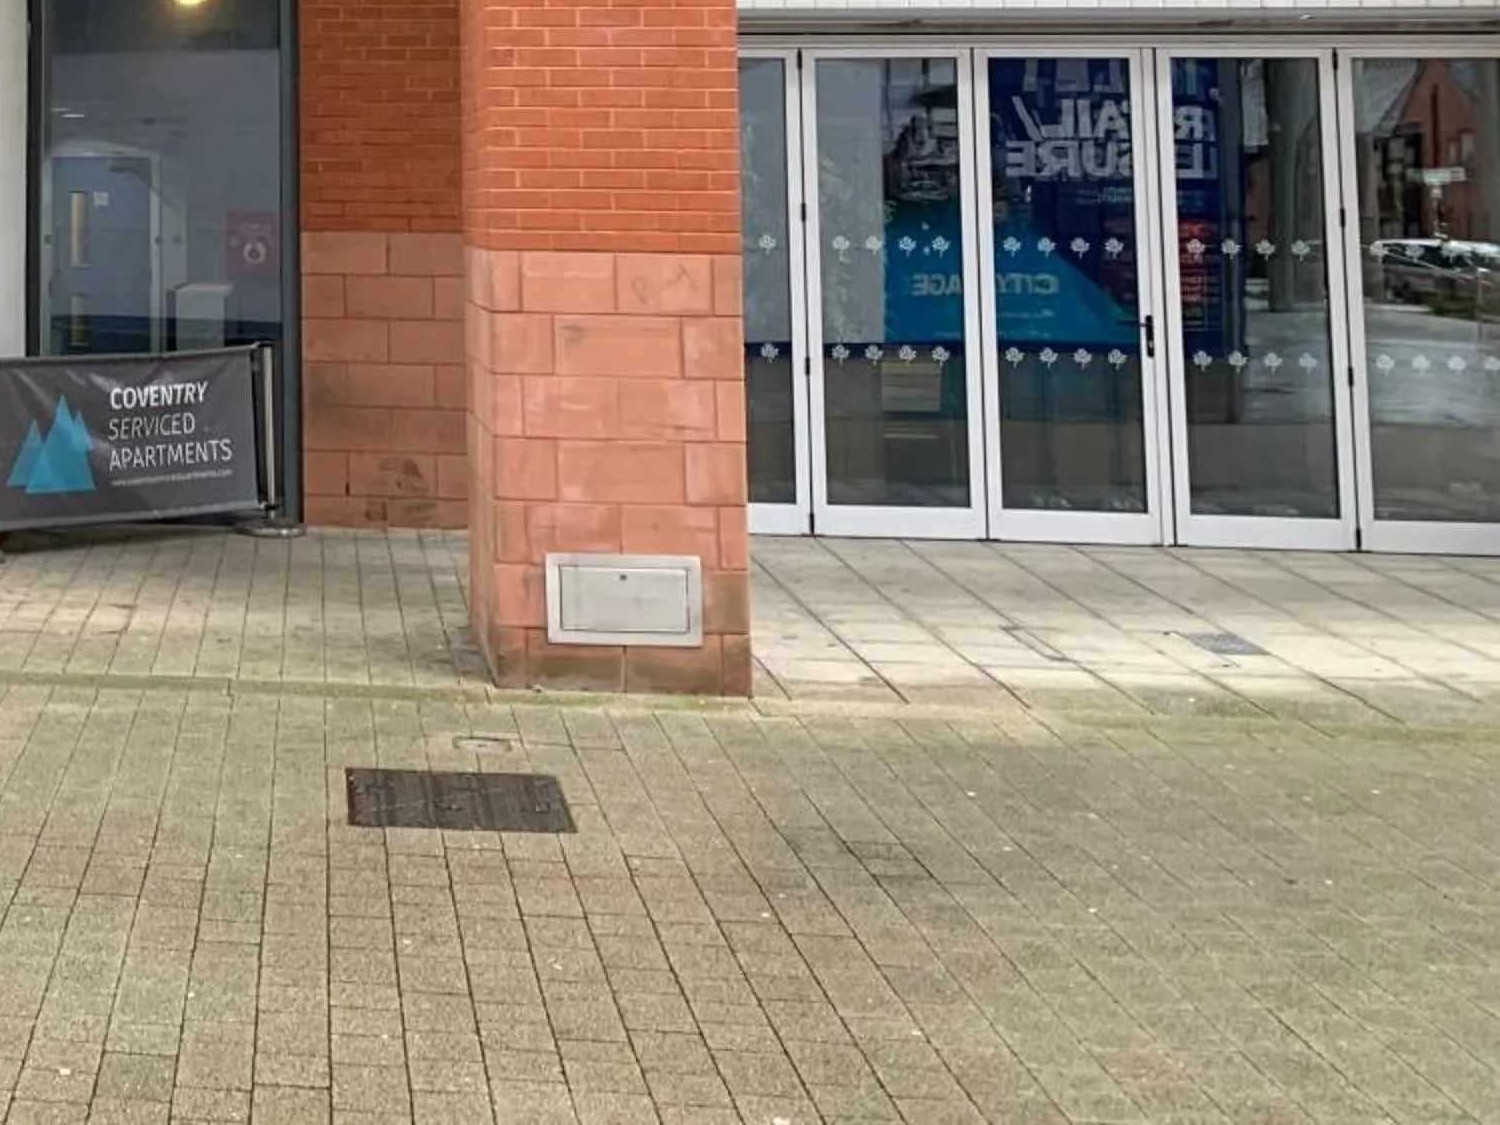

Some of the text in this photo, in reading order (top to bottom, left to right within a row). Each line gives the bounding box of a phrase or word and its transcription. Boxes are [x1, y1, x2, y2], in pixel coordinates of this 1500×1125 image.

[110, 380, 208, 410] COVENTRY
[108, 412, 196, 441] SERVICED
[109, 438, 233, 472] APARTMENTS
